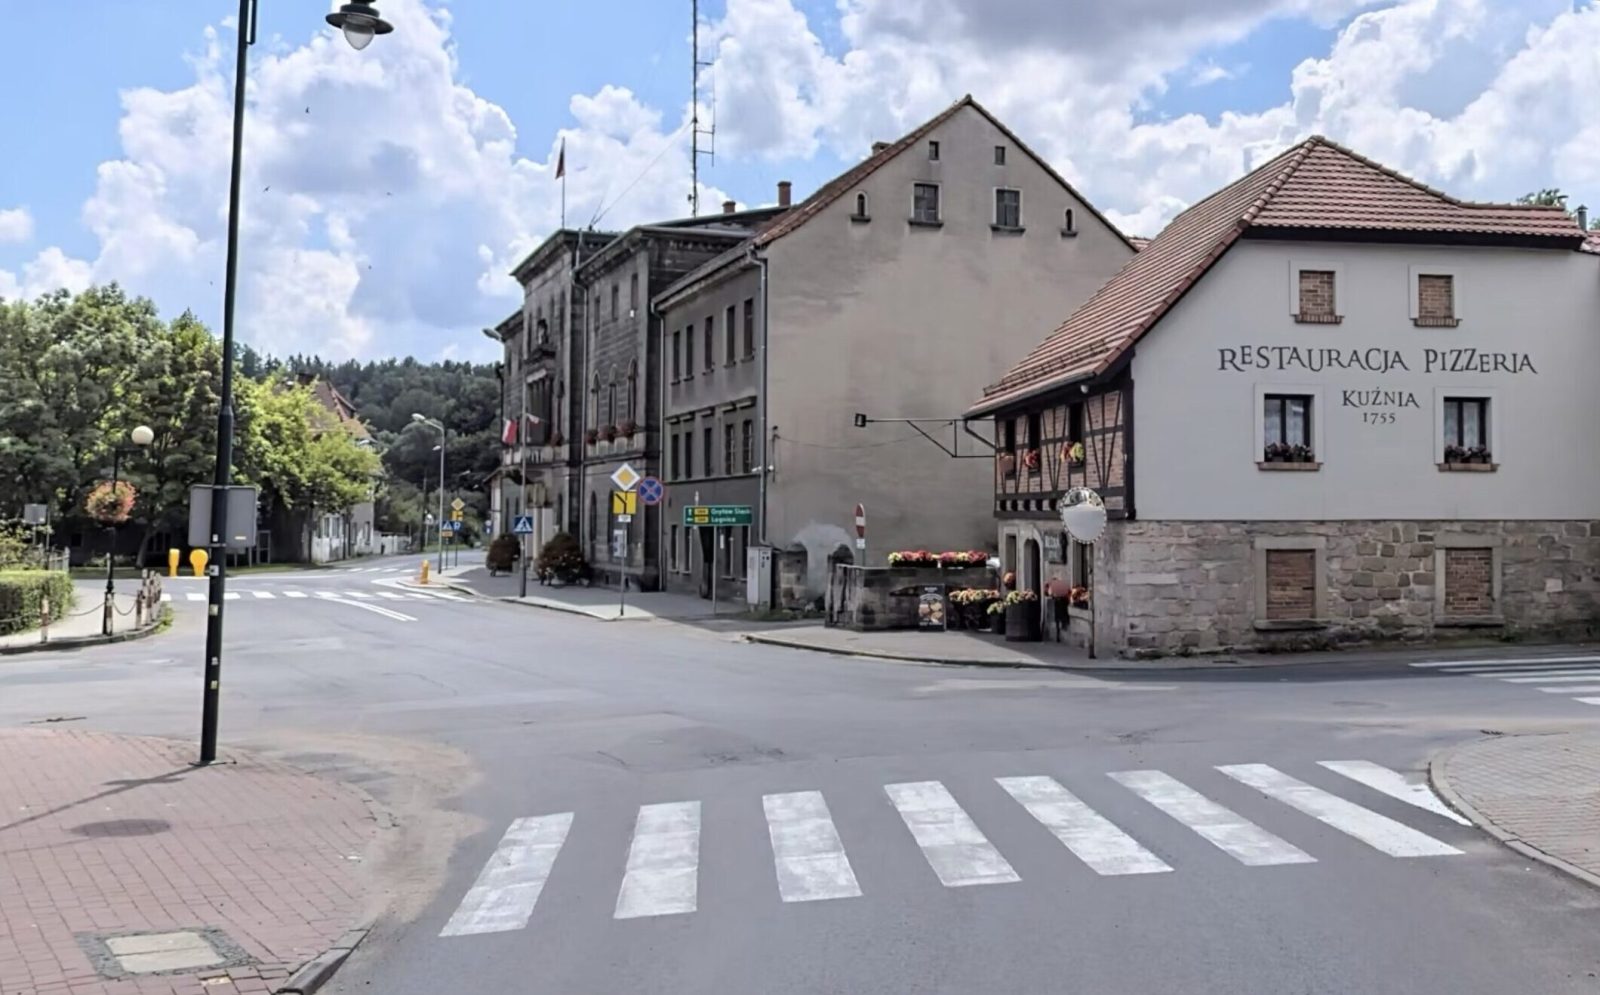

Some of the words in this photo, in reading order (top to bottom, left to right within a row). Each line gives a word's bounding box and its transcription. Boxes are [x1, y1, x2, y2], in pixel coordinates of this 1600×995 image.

[1217, 345, 1411, 374] RESTAURACJA
[1423, 348, 1539, 374] PIZZERIA
[1363, 412, 1396, 425] 1755
